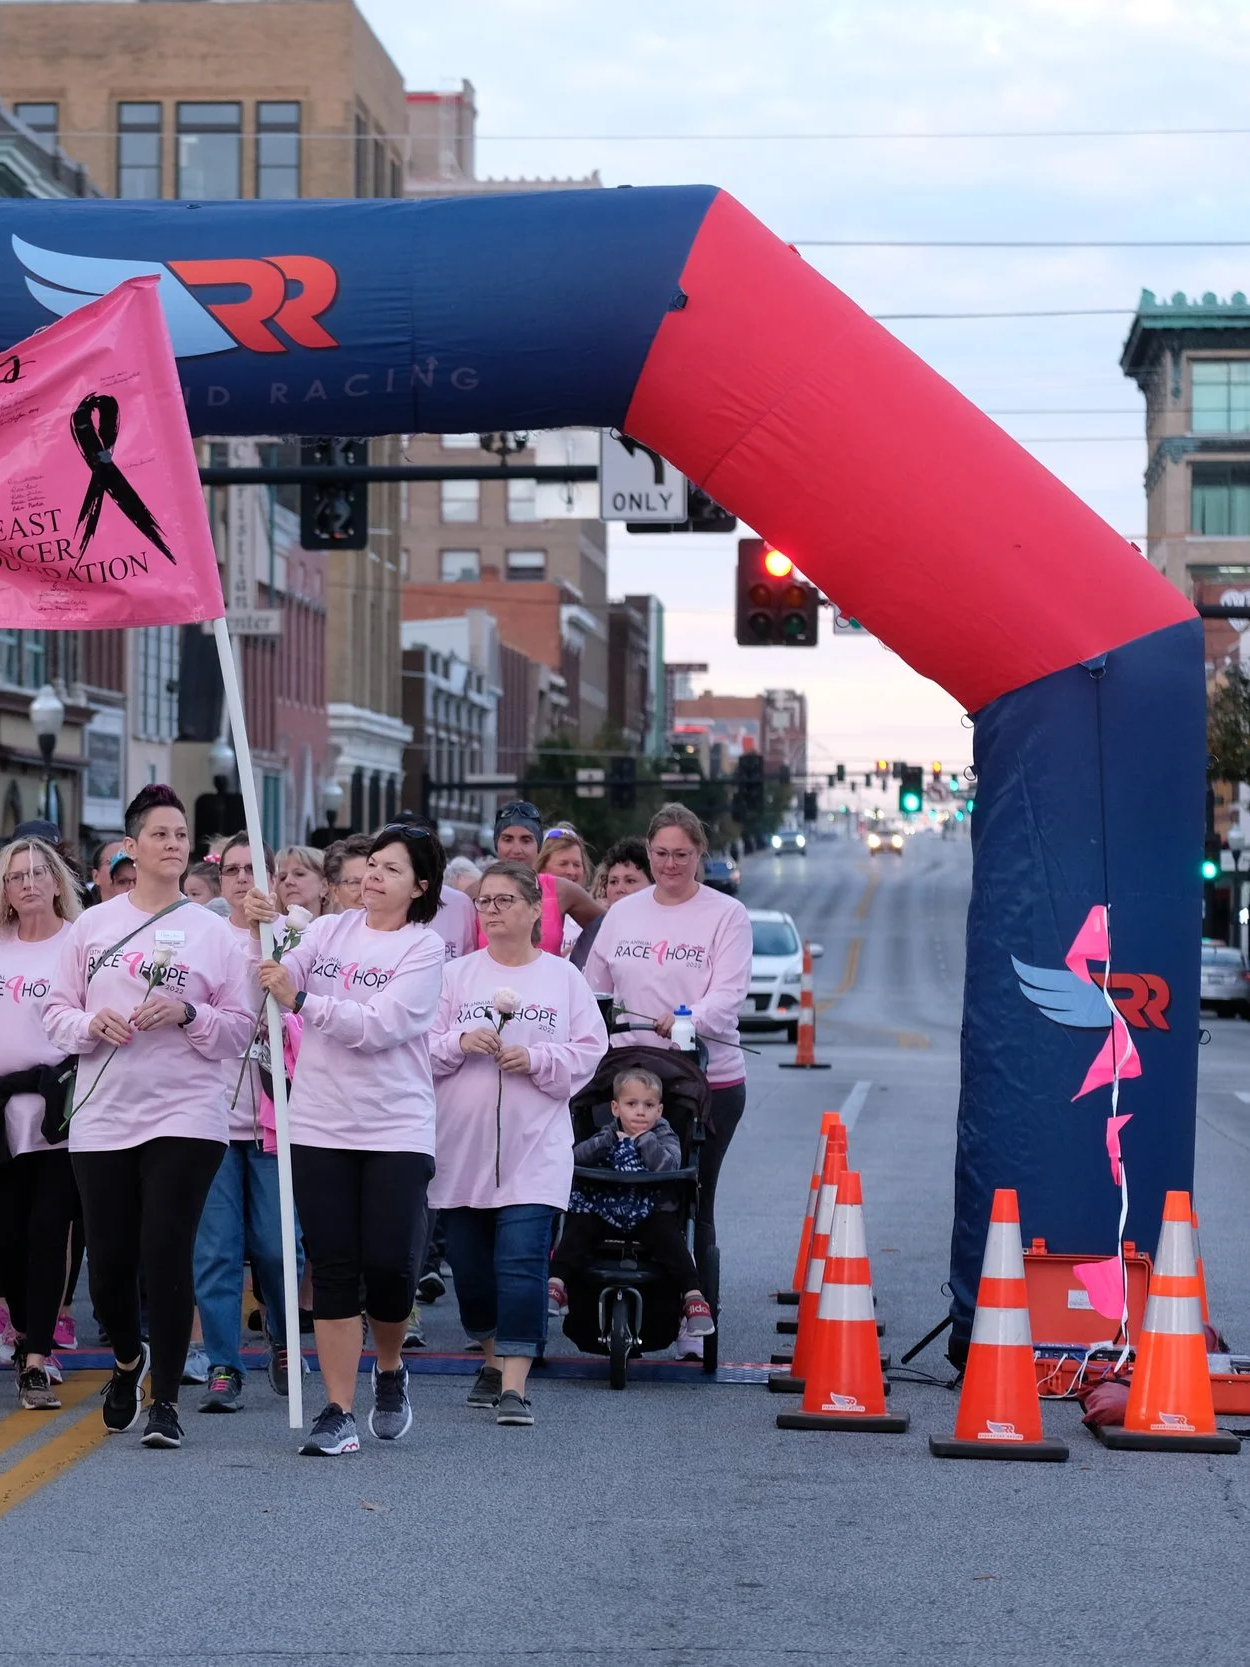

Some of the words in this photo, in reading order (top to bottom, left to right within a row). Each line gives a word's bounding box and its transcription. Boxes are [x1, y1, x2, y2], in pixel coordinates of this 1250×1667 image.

[166, 255, 340, 353] RR
[269, 355, 479, 404] RACING
[612, 492, 673, 512] ONLY
[232, 440, 250, 610] Cristian
[210, 614, 274, 630] enter
[121, 951, 145, 980] 4
[614, 945, 650, 960] RACE
[650, 938, 669, 967] 4
[665, 947, 706, 963] HOPE
[685, 961, 702, 969] 2022
[4, 974, 26, 1004] 4
[21, 982, 51, 998] HO
[339, 961, 360, 991] 4
[352, 969, 392, 989] HOP
[512, 1007, 558, 1028] HOPE
[538, 1023, 555, 1035] 2022
